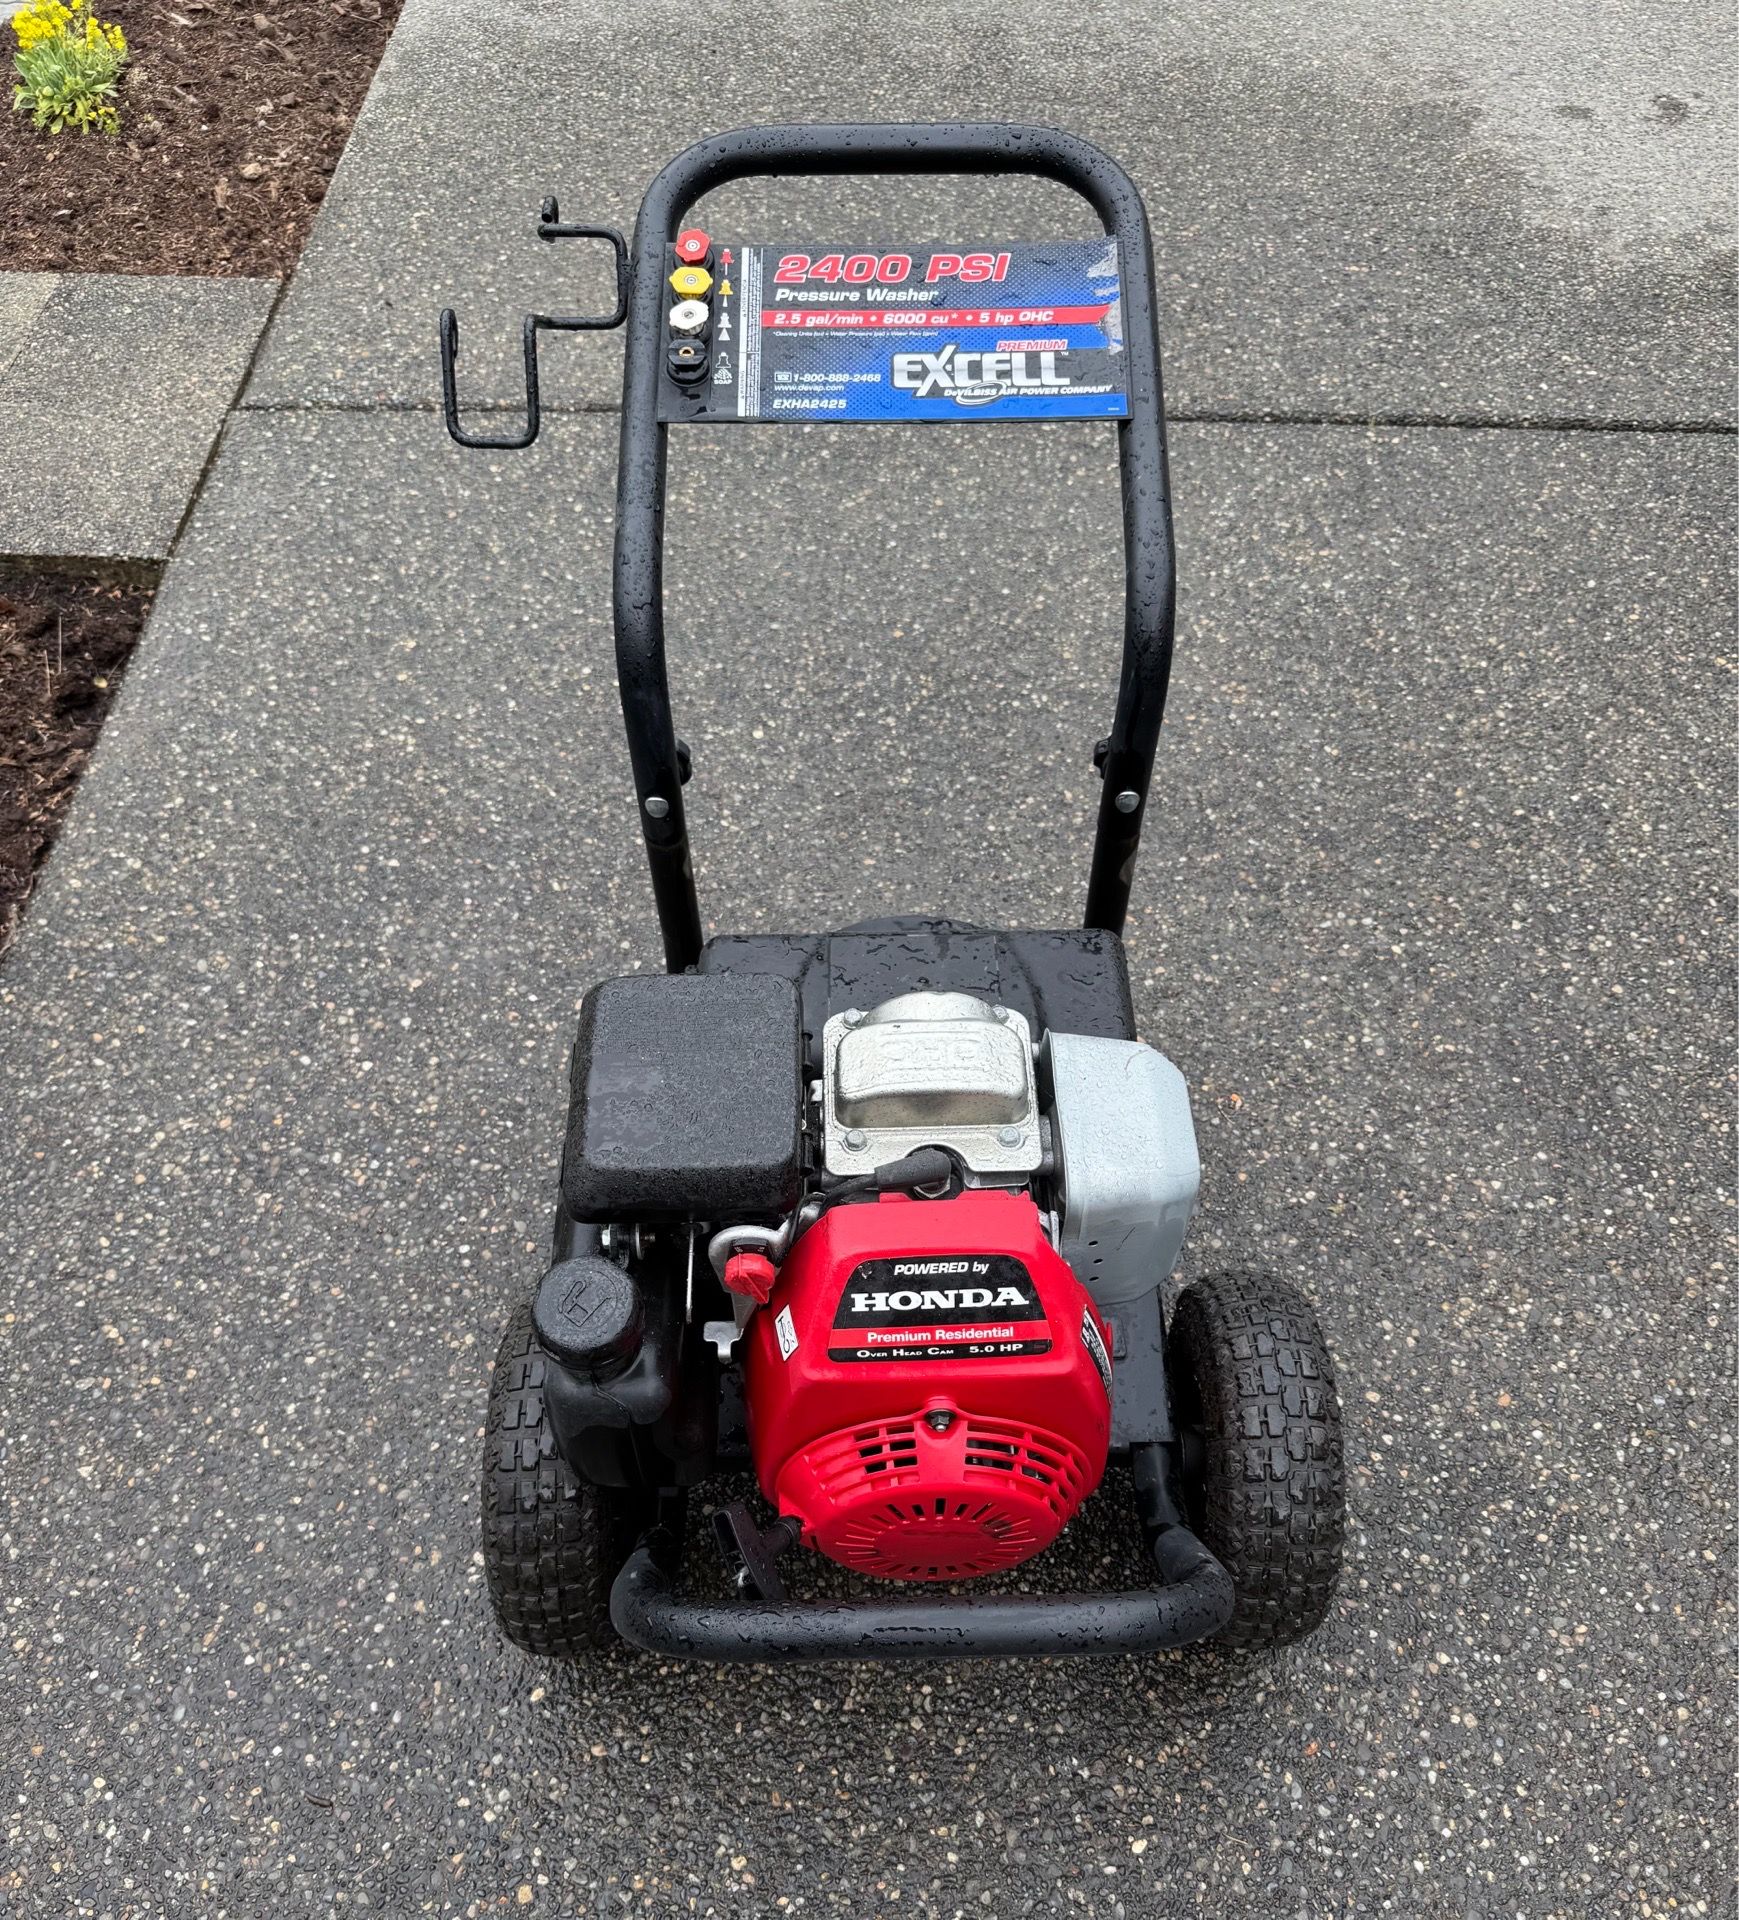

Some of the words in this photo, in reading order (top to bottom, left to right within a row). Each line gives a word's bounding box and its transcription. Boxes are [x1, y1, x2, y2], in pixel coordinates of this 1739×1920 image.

[774, 254, 913, 283] 2400
[925, 252, 1012, 283] PSI
[775, 288, 860, 302] Pressure
[866, 288, 939, 301] Washer
[774, 312, 802, 325] 2.5
[805, 312, 864, 327] gal/min
[883, 312, 927, 324] 6000
[979, 312, 991, 323] 5
[995, 312, 1014, 325] hp
[1019, 310, 1054, 322] OHC
[996, 340, 1068, 351] PREMIUM
[793, 373, 882, 383] 1-800-888-2468
[774, 384, 845, 392] www.devap.com
[1000, 387, 1018, 396] AIR
[1019, 386, 1061, 395] POWER
[1061, 384, 1113, 394] COMPANY
[773, 399, 848, 409] EXHA2425
[894, 1262, 969, 1276] POWERED
[972, 1261, 989, 1274] by
[851, 1287, 1030, 1312] HONDA
[867, 1330, 931, 1343] Premium
[935, 1327, 1014, 1341] Residential
[969, 1345, 995, 1354] 5.0
[1000, 1343, 1024, 1352] HP
